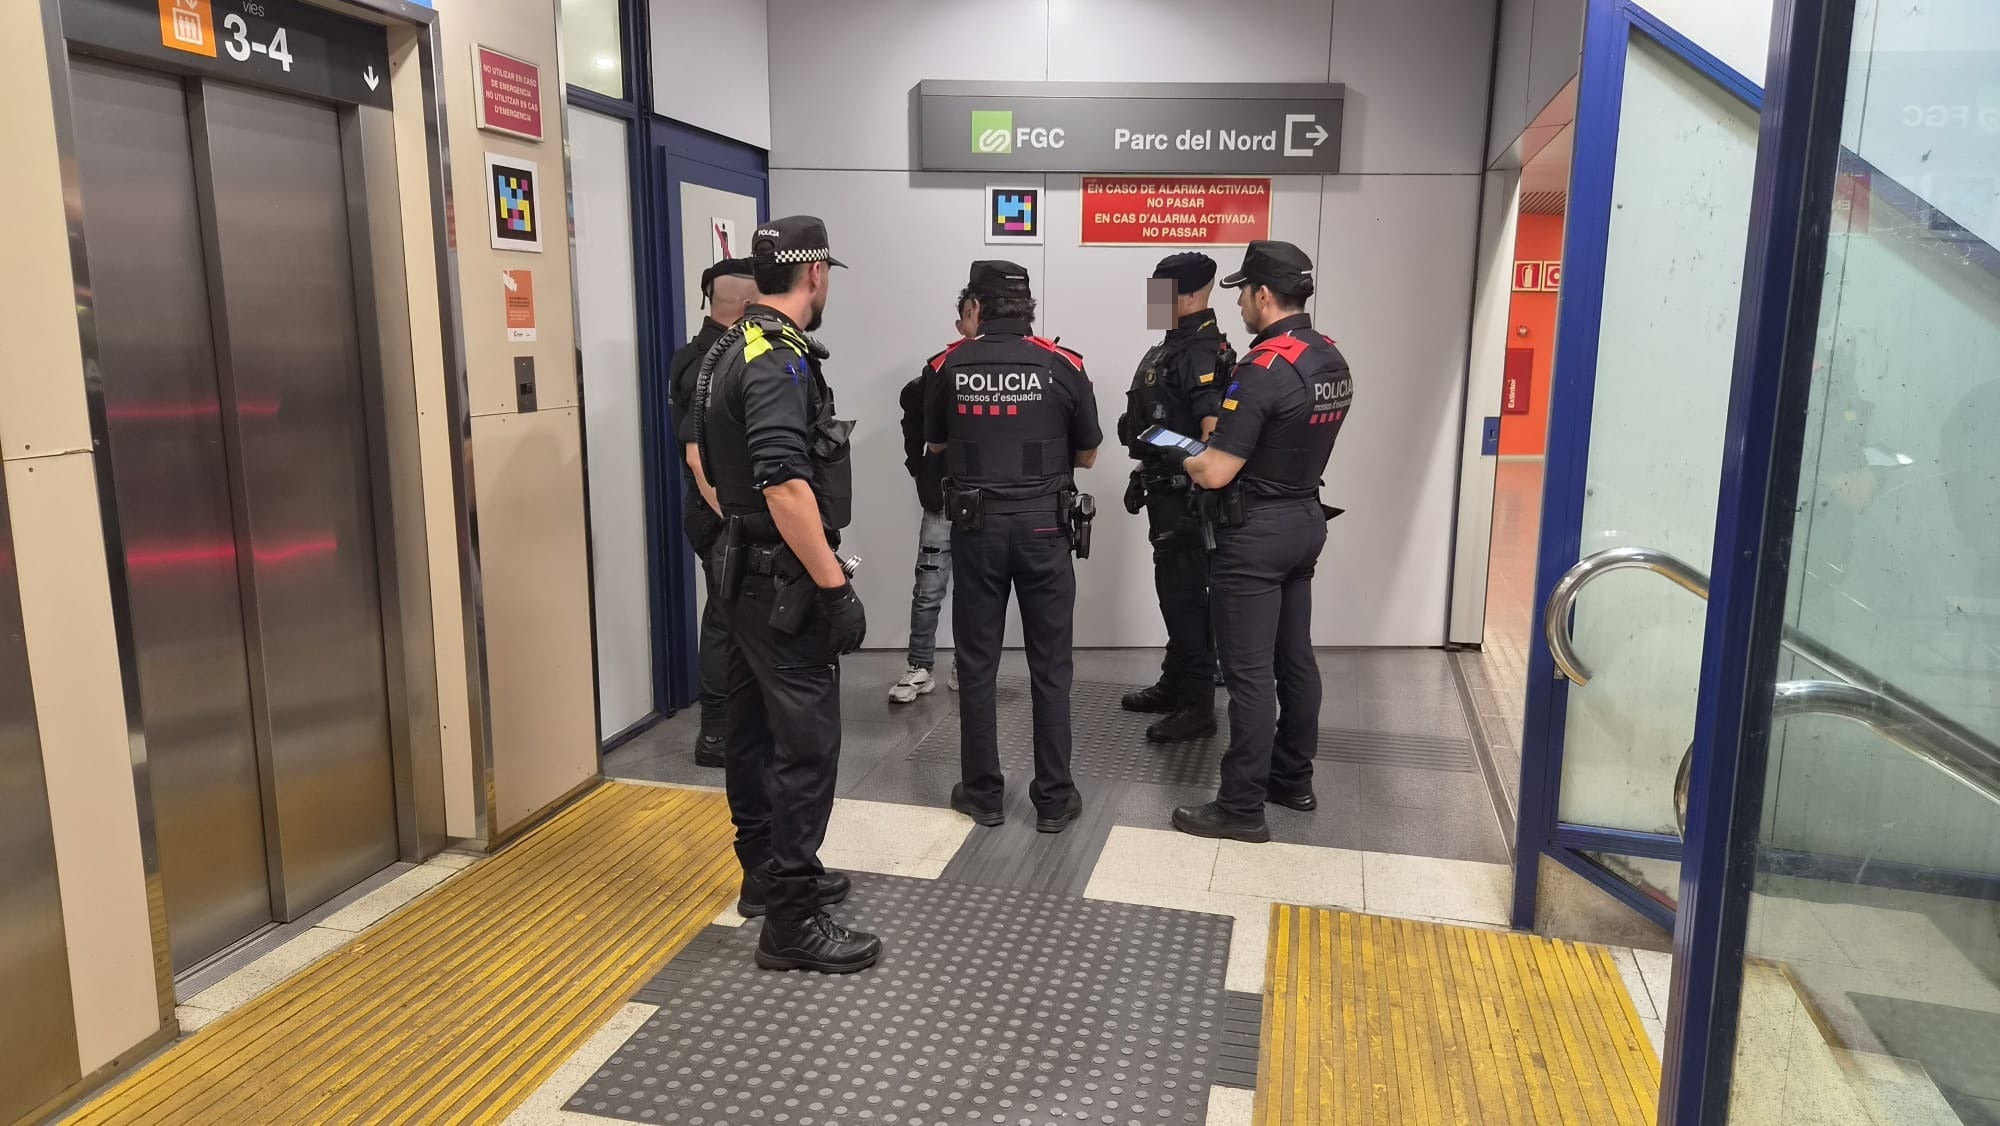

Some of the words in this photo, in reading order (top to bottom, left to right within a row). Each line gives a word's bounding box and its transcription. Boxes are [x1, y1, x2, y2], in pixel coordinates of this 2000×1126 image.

[243, 1, 265, 17] vies
[224, 13, 293, 72] 3-4
[483, 64, 492, 73] NO
[492, 67, 515, 80] UTILIZAR
[516, 74, 522, 83] EN
[523, 76, 537, 88] CASO
[491, 79, 498, 88] DE
[499, 82, 532, 97] EMERGENCIA
[485, 90, 494, 100] NO
[495, 92, 520, 106] UTILITZAR
[520, 100, 527, 109] EN
[528, 102, 538, 112] CAS
[1016, 127, 1065, 149] FGC
[1114, 128, 1168, 150] Parc
[1175, 129, 1212, 151] del
[1219, 129, 1277, 151] Nord
[1087, 184, 1103, 194] EN
[1105, 184, 1137, 194] CASO
[1140, 184, 1156, 194] DE
[1158, 184, 1206, 195] ALARMA
[1208, 184, 1264, 195] ACTIVADA
[1147, 198, 1164, 208] NO
[1166, 198, 1205, 208] PASAR
[1094, 213, 1111, 223] EN
[1112, 213, 1136, 224] CAS
[1139, 213, 1197, 224] D'ALARMA
[1199, 214, 1255, 224] ACTIVADA
[758, 229, 779, 237] POLICIA
[1142, 227, 1159, 237] NO
[1161, 227, 1207, 238] PASSAR
[955, 373, 1042, 391] POLICIA
[957, 393, 990, 402] mossos
[992, 391, 1042, 403] d'esquadra
